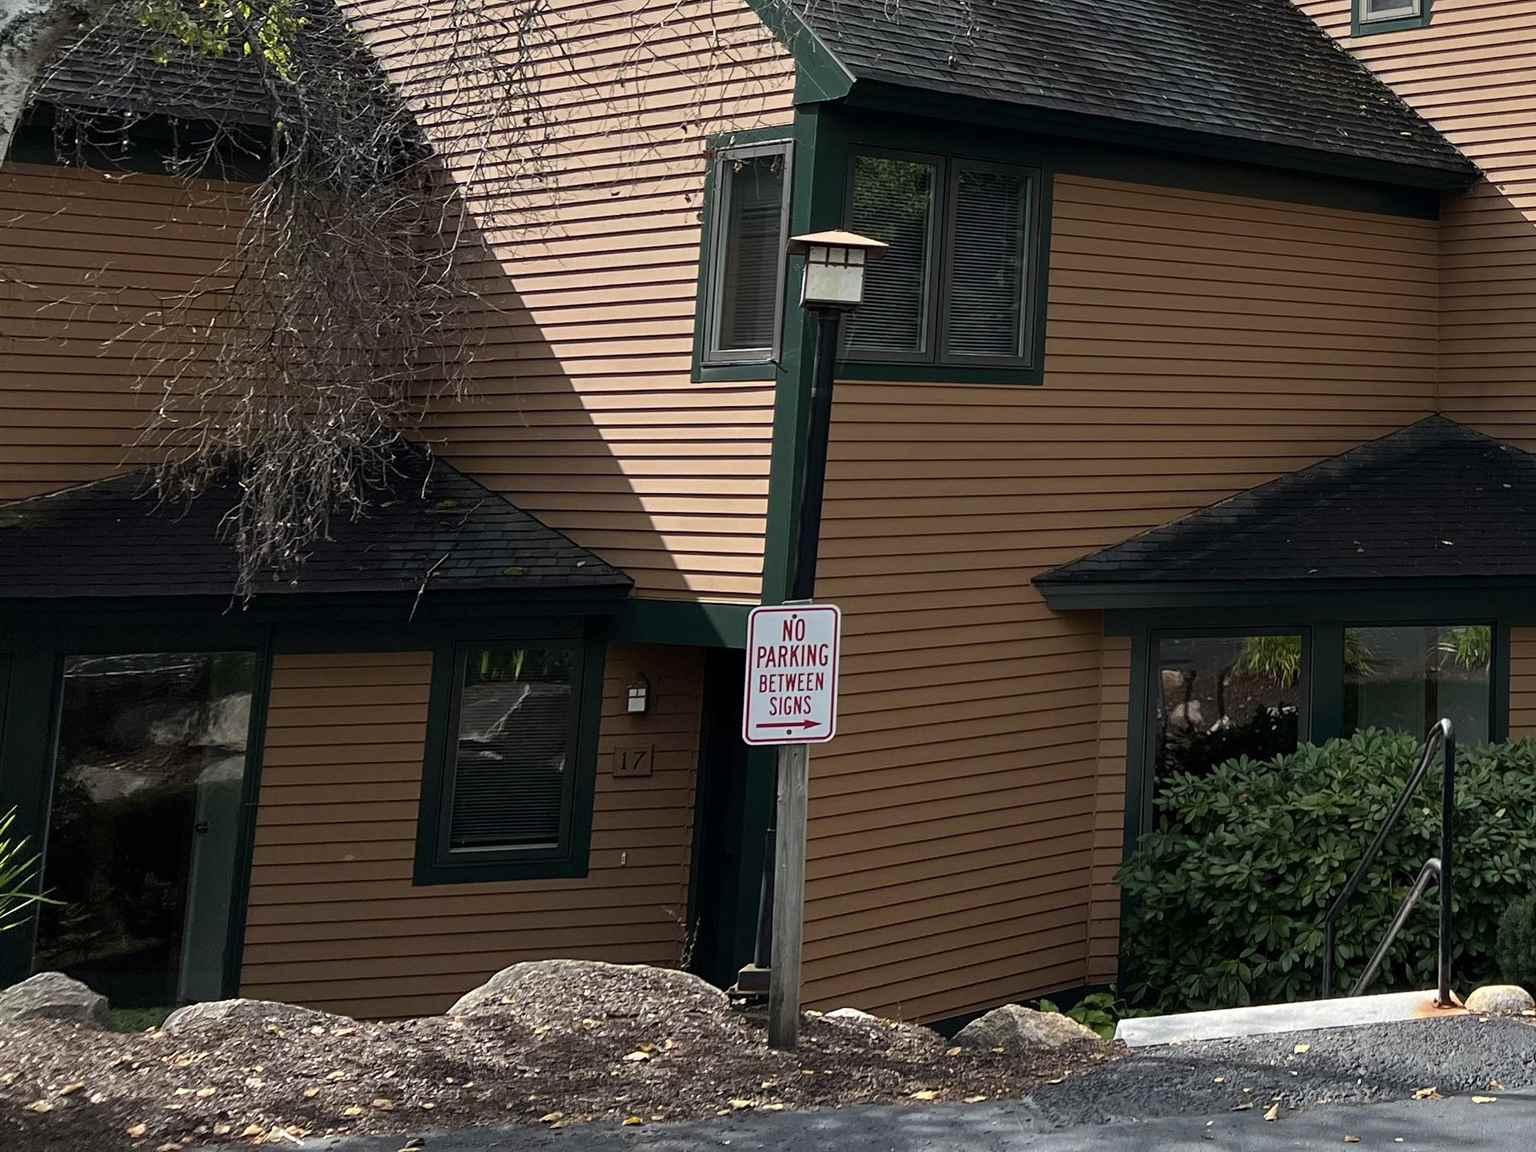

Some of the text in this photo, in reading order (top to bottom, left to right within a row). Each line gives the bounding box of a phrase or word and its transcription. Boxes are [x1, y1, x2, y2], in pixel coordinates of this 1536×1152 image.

[782, 618, 806, 642] NO
[756, 643, 829, 668] PARKING
[759, 672, 825, 693] BETWEEN
[769, 695, 812, 716] SIGNS
[620, 752, 648, 770] 17
